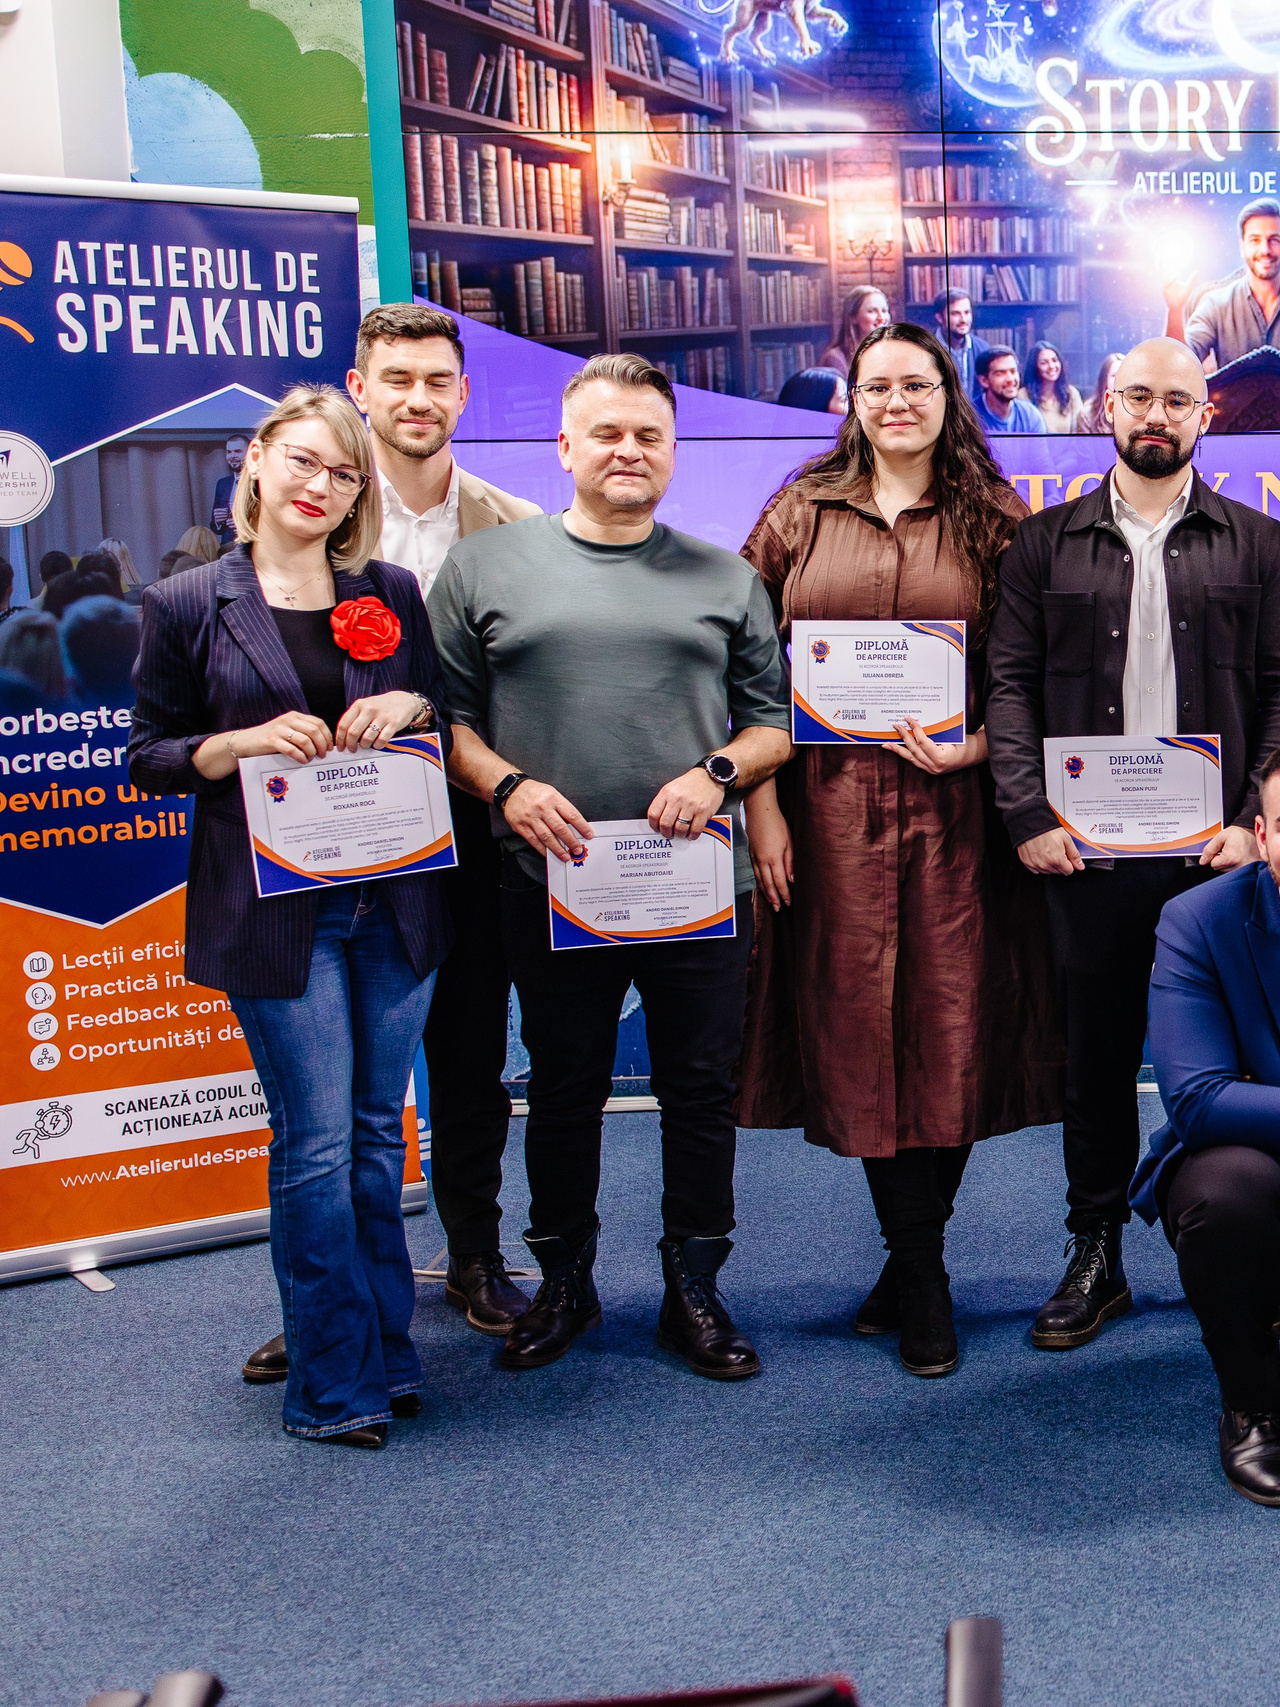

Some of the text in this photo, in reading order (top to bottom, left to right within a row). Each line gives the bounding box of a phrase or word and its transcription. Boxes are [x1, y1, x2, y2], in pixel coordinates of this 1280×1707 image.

[1024, 57, 1255, 167] STORY
[1133, 171, 1243, 195] ATELIERUL
[1249, 171, 1276, 195] DE
[53, 240, 321, 294] ATELIERUL DE
[55, 292, 324, 359] SPEAKING
[854, 638, 909, 650] DIPLOMĂ
[315, 760, 379, 782] DIPLOMĂ
[1108, 752, 1164, 765] DIPLOMĂ
[319, 777, 379, 793] DE APRECIERE
[332, 801, 359, 810] ROXANA
[312, 850, 342, 861] SPEAKING
[628, 851, 671, 860] APRECIERE
[603, 914, 630, 922] SPEAKING
[62, 940, 186, 970] Lecții efici
[64, 971, 196, 1000] Practică in
[67, 1001, 180, 1031] Feedback
[68, 1024, 245, 1062] Oportunități de
[104, 1089, 191, 1117] SCANEAZĂ
[195, 1084, 247, 1104] CODUL
[121, 1106, 224, 1137] ACȚIONEAZĂ
